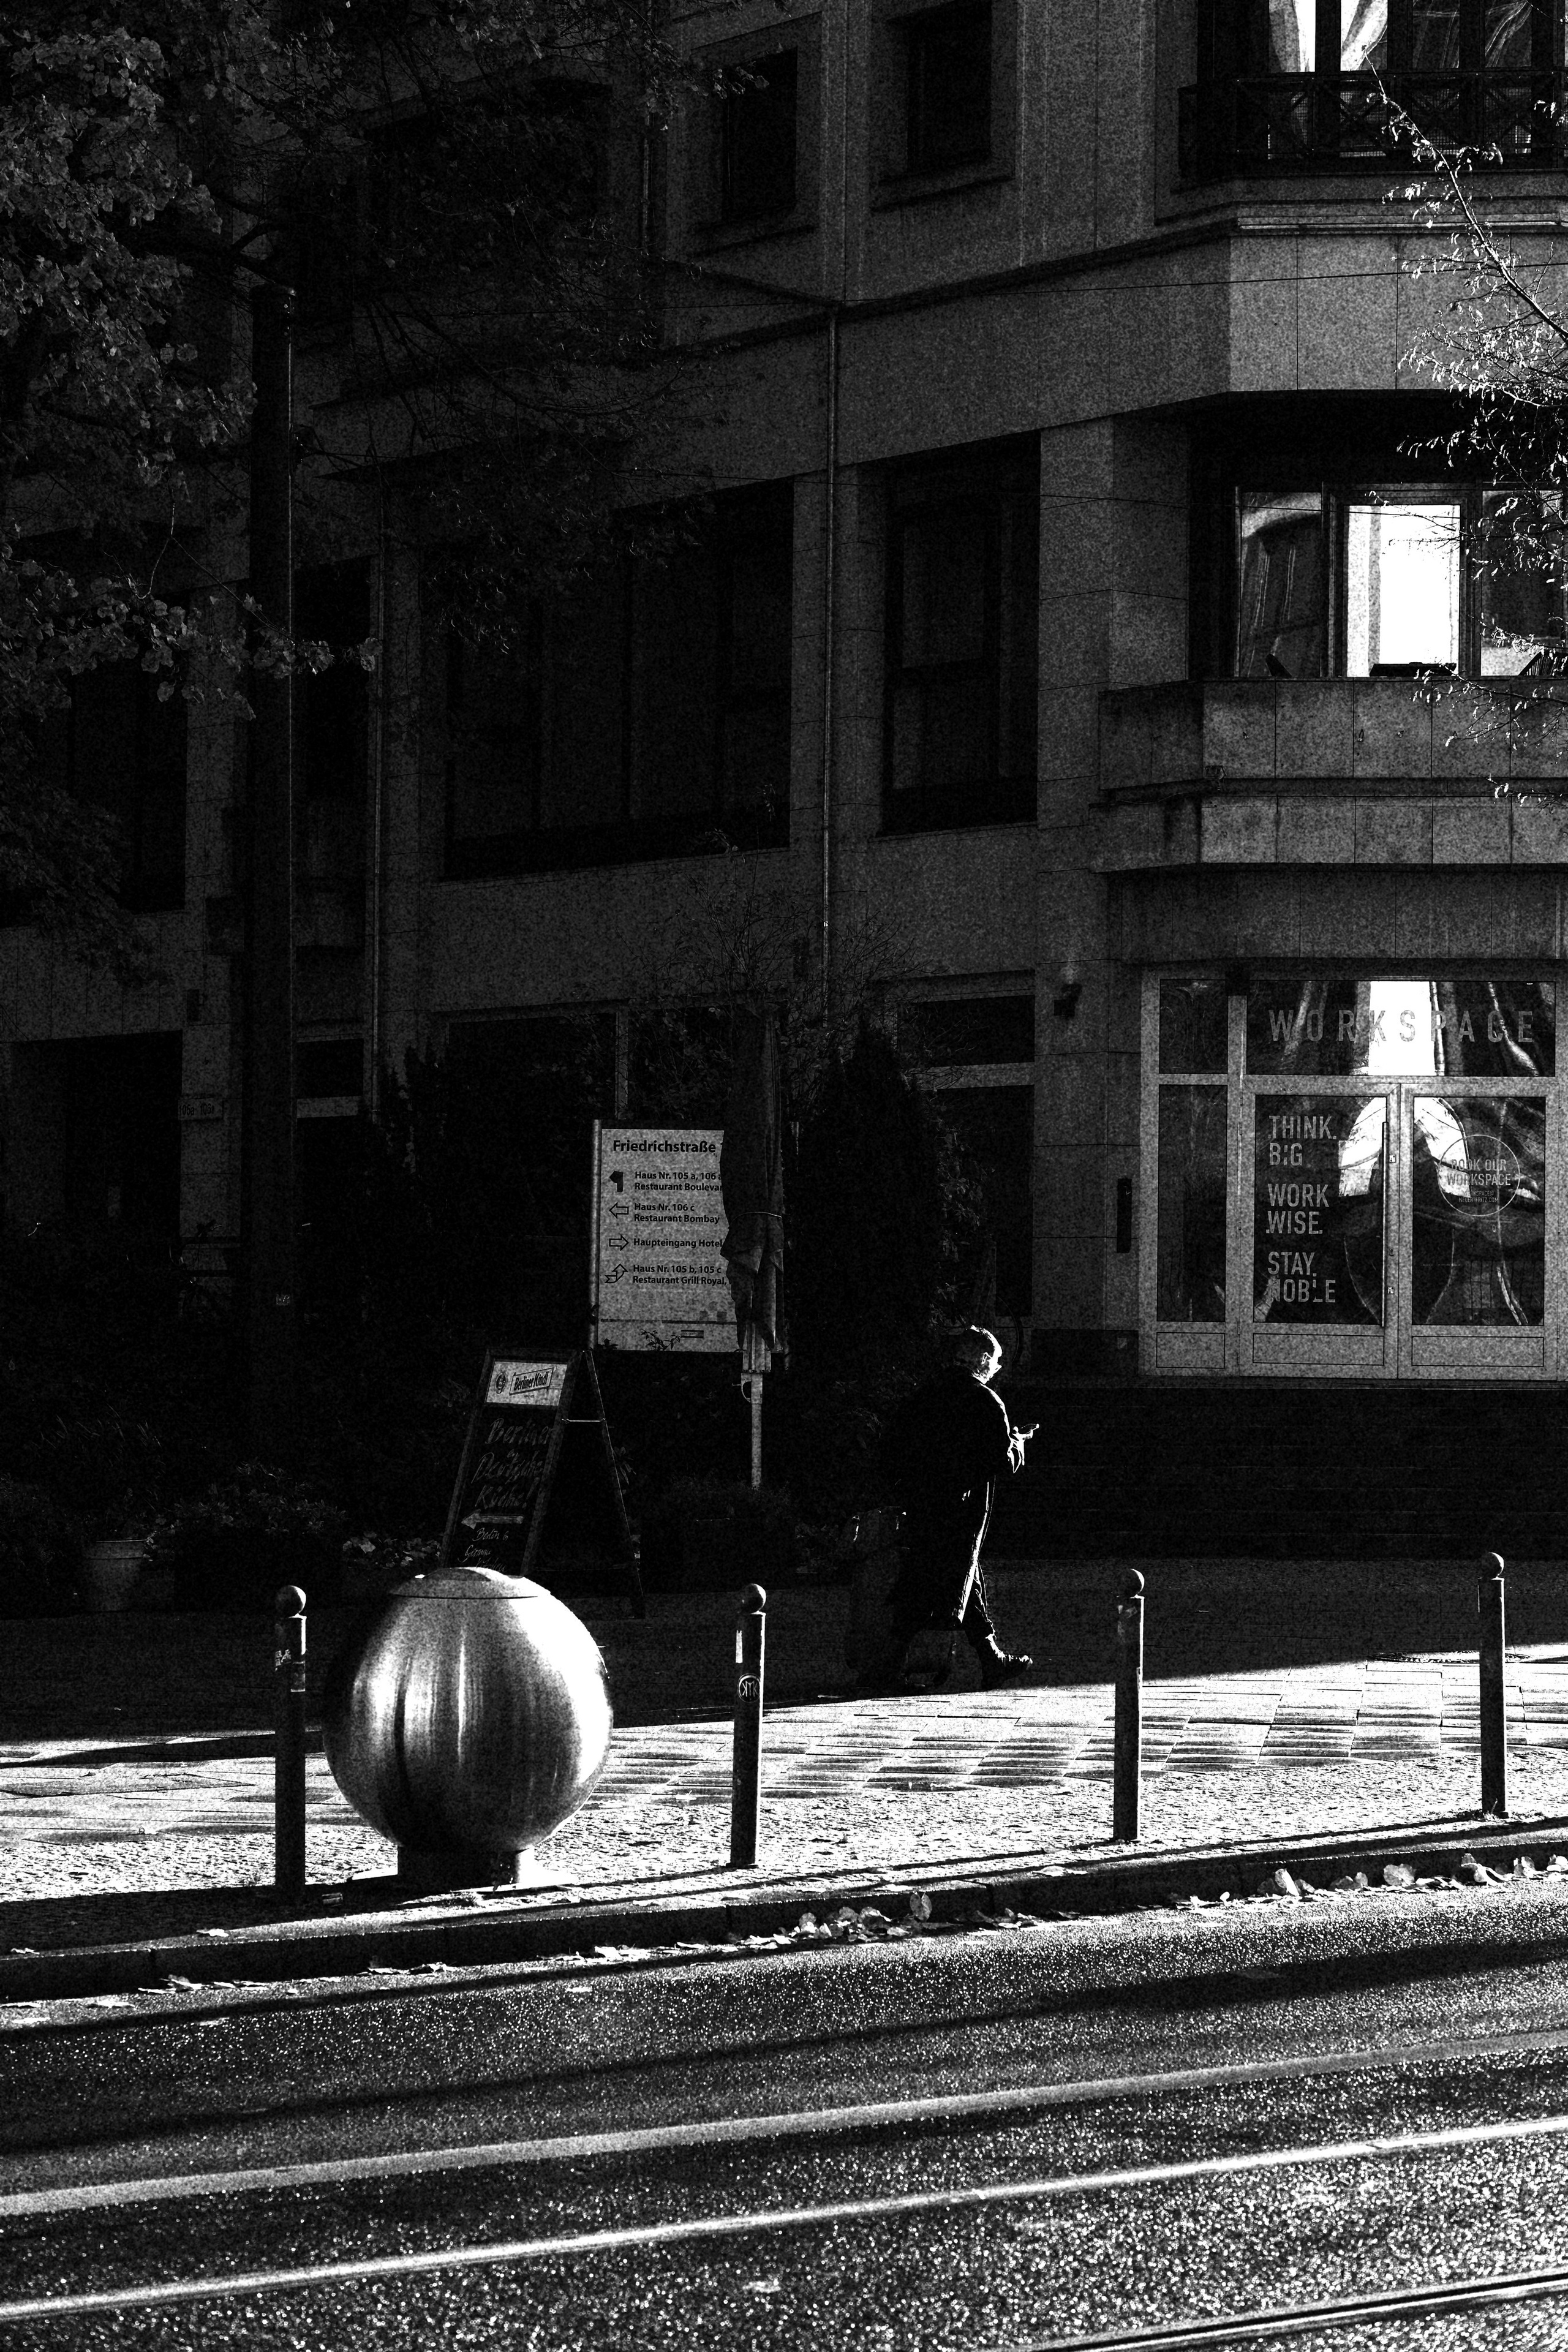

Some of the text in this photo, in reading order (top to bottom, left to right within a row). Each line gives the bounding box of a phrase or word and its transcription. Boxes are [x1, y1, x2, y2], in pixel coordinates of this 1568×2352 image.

[1268, 1009, 1534, 1043] WORKSPACE
[612, 1139, 717, 1153] Friedrichstraße
[1268, 1142, 1303, 1166] BIG
[1451, 1159, 1507, 1171] BOOK OUR
[635, 1170, 657, 1180] Haus
[658, 1171, 671, 1180] Nr.
[673, 1172, 689, 1180] 105
[1446, 1173, 1512, 1186] WORKSPACE
[635, 1182, 683, 1191] Restaurant
[1267, 1183, 1330, 1208] WORK
[634, 1202, 657, 1211] Haus
[658, 1203, 671, 1212] Nr.
[634, 1214, 720, 1224] Restaurant Bombay
[633, 1238, 697, 1248] Haupteingang
[633, 1264, 655, 1273] Haus
[657, 1265, 670, 1273] Nr.
[671, 1265, 687, 1273] 105
[688, 1265, 698, 1275] b,
[633, 1275, 728, 1287] Restaurant Grill Royal,
[1268, 1278, 1336, 1303] NOBLE
[513, 1371, 550, 1392] Berliner Kindl
